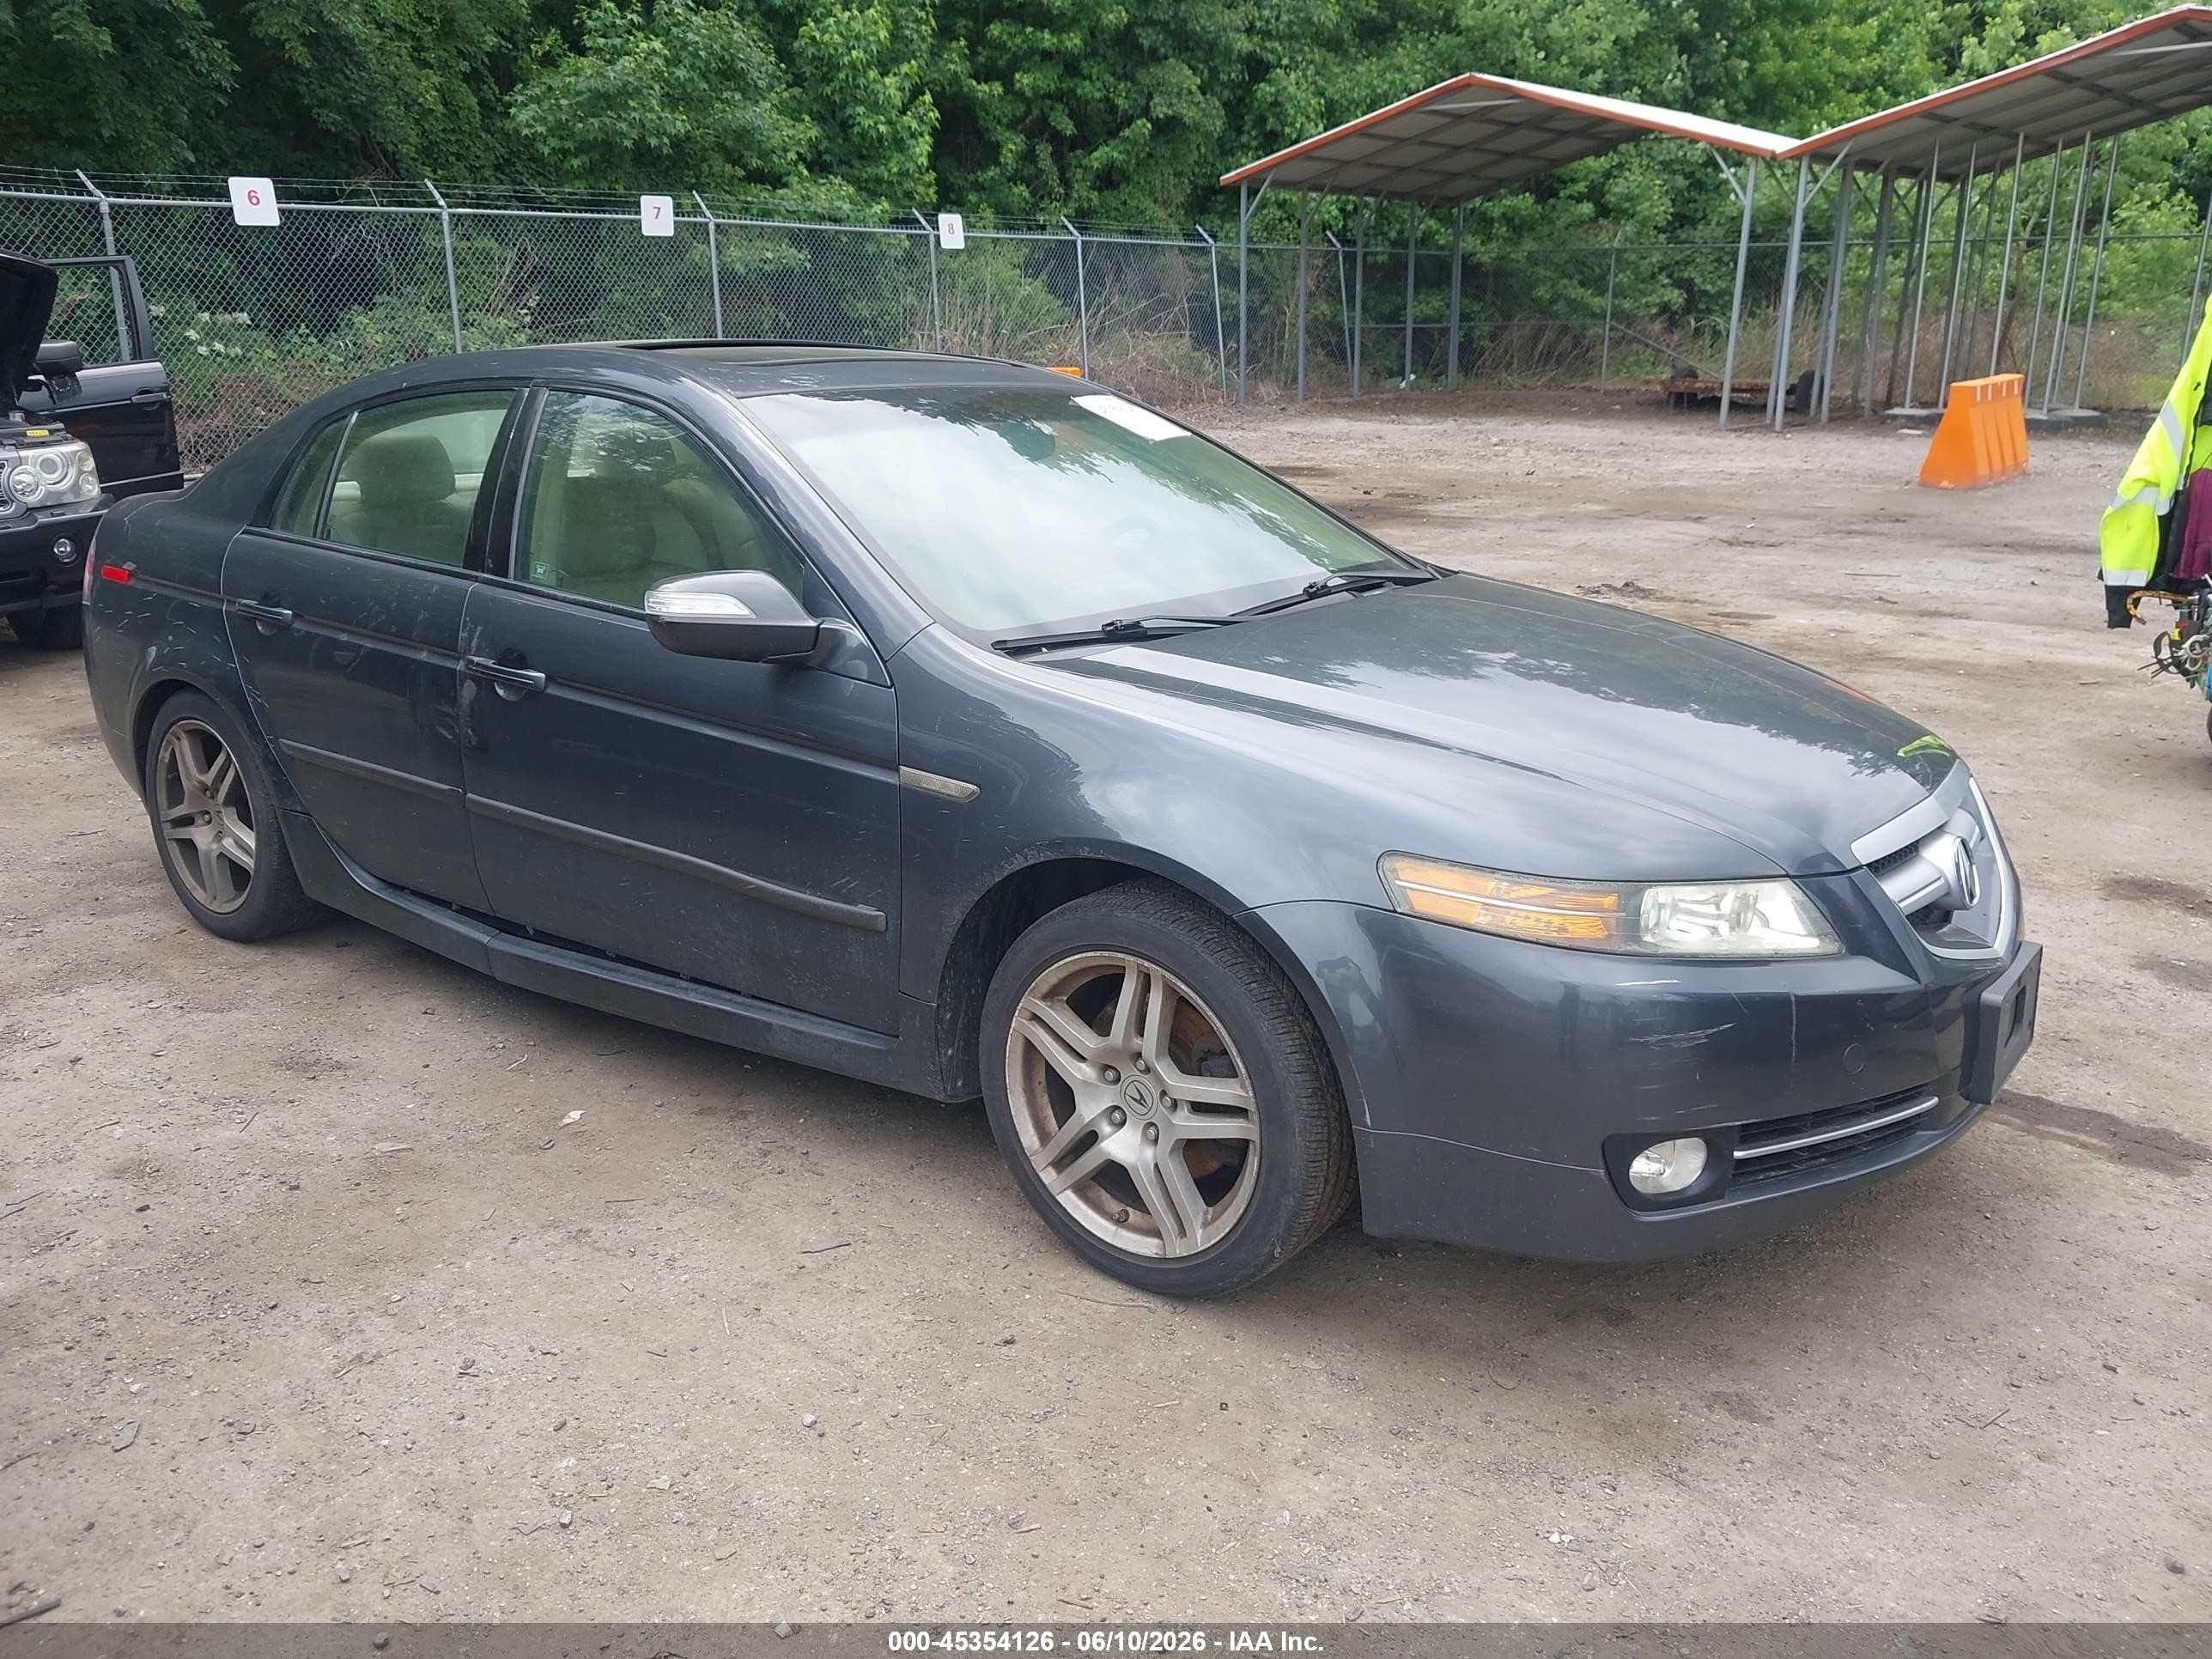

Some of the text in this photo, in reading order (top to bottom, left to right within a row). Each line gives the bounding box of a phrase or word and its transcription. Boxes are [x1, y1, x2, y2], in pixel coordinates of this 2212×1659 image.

[247, 189, 261, 206] 6
[653, 206, 661, 220] 7
[947, 222, 955, 235] 8
